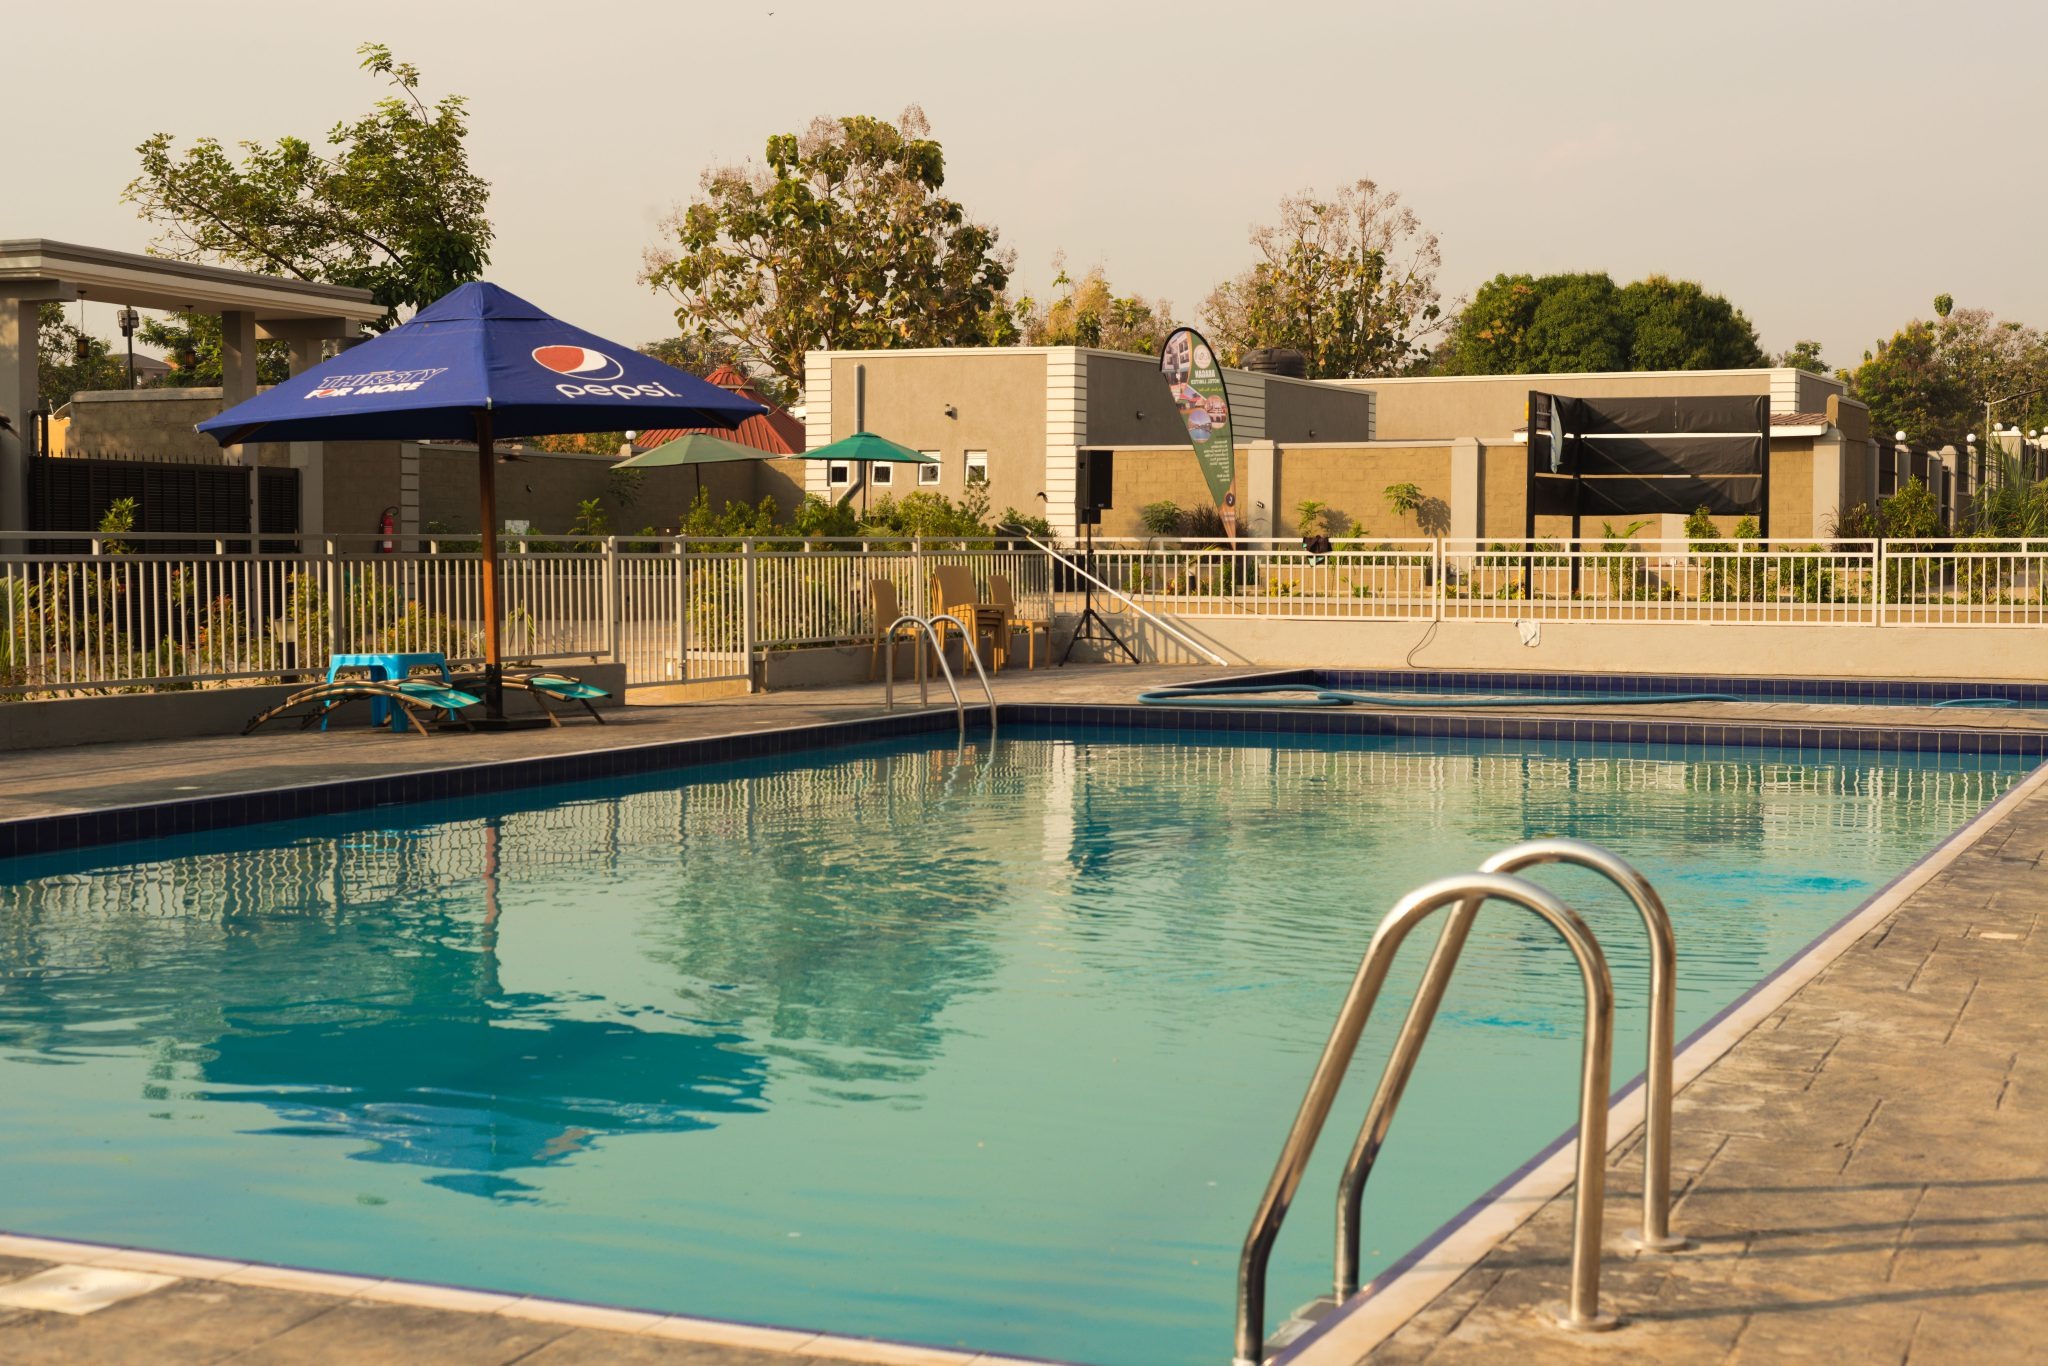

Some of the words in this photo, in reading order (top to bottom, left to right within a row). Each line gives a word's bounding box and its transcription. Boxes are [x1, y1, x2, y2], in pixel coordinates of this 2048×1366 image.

[317, 367, 448, 389] THIRSTY
[304, 387, 353, 399] FOR
[353, 381, 425, 395] MORE
[555, 381, 677, 400] pepsi
